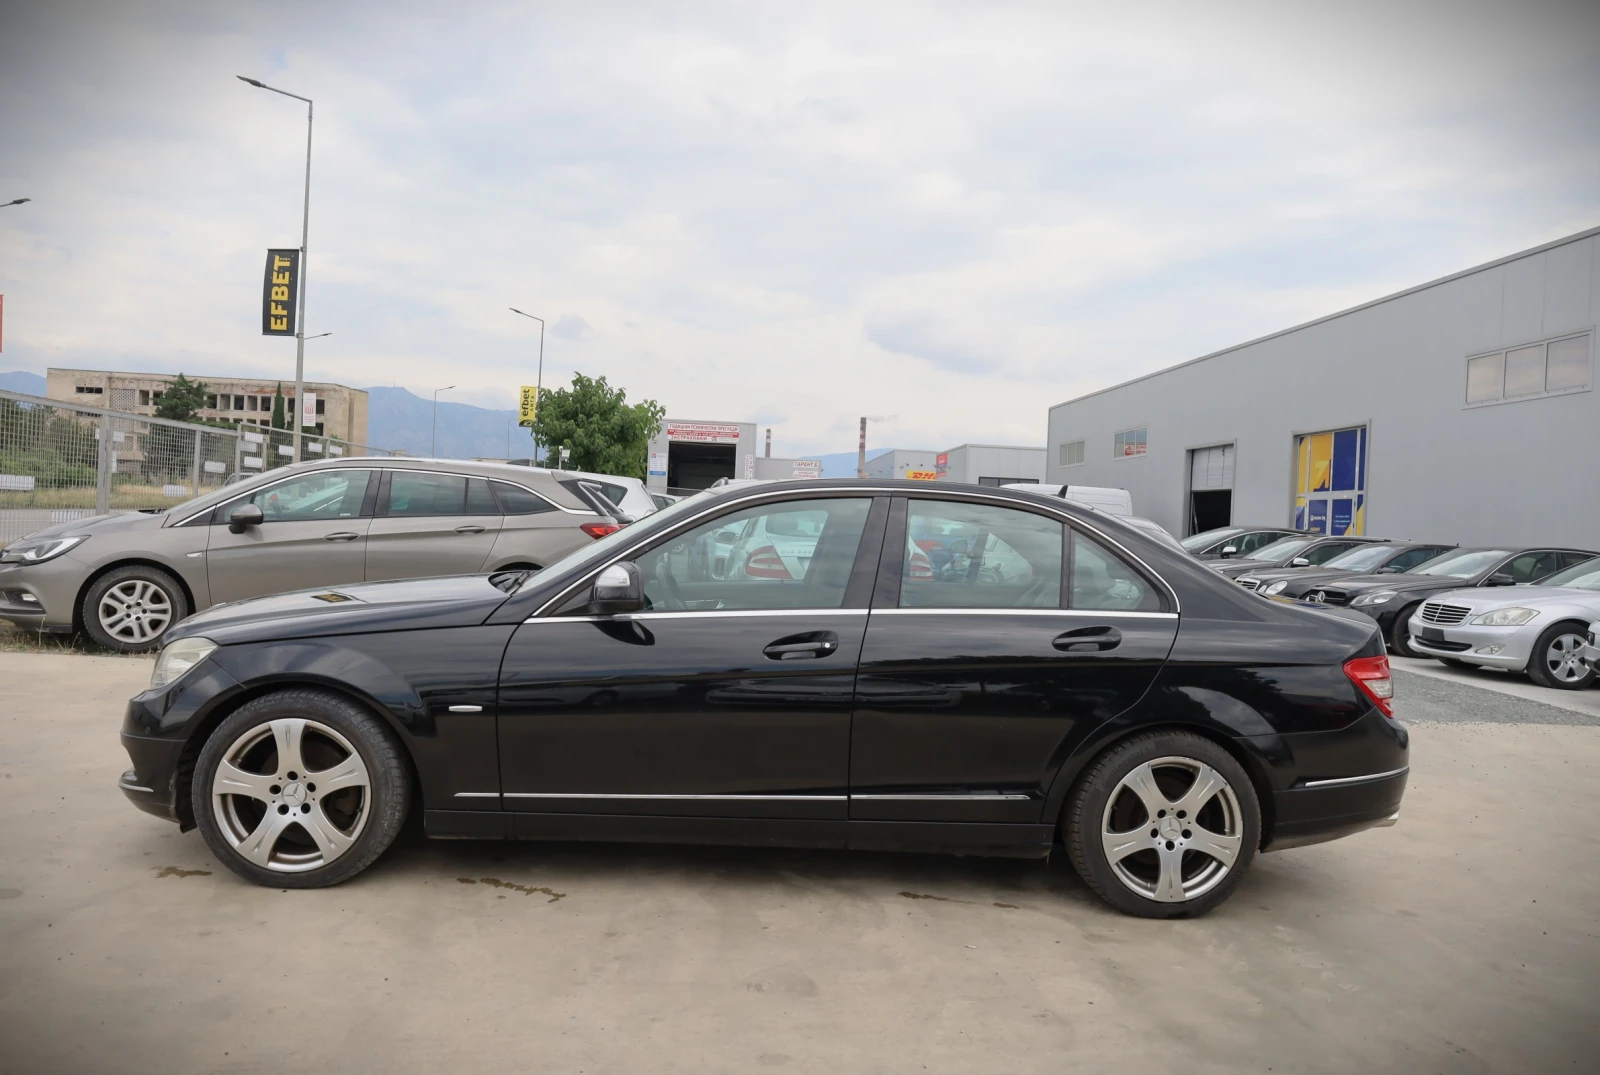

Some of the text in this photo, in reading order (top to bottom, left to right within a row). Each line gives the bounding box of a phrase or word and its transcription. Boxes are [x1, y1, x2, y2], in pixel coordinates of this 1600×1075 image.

[270, 254, 291, 331] EFBET
[522, 389, 530, 416] efbet
[912, 472, 936, 480] DH
